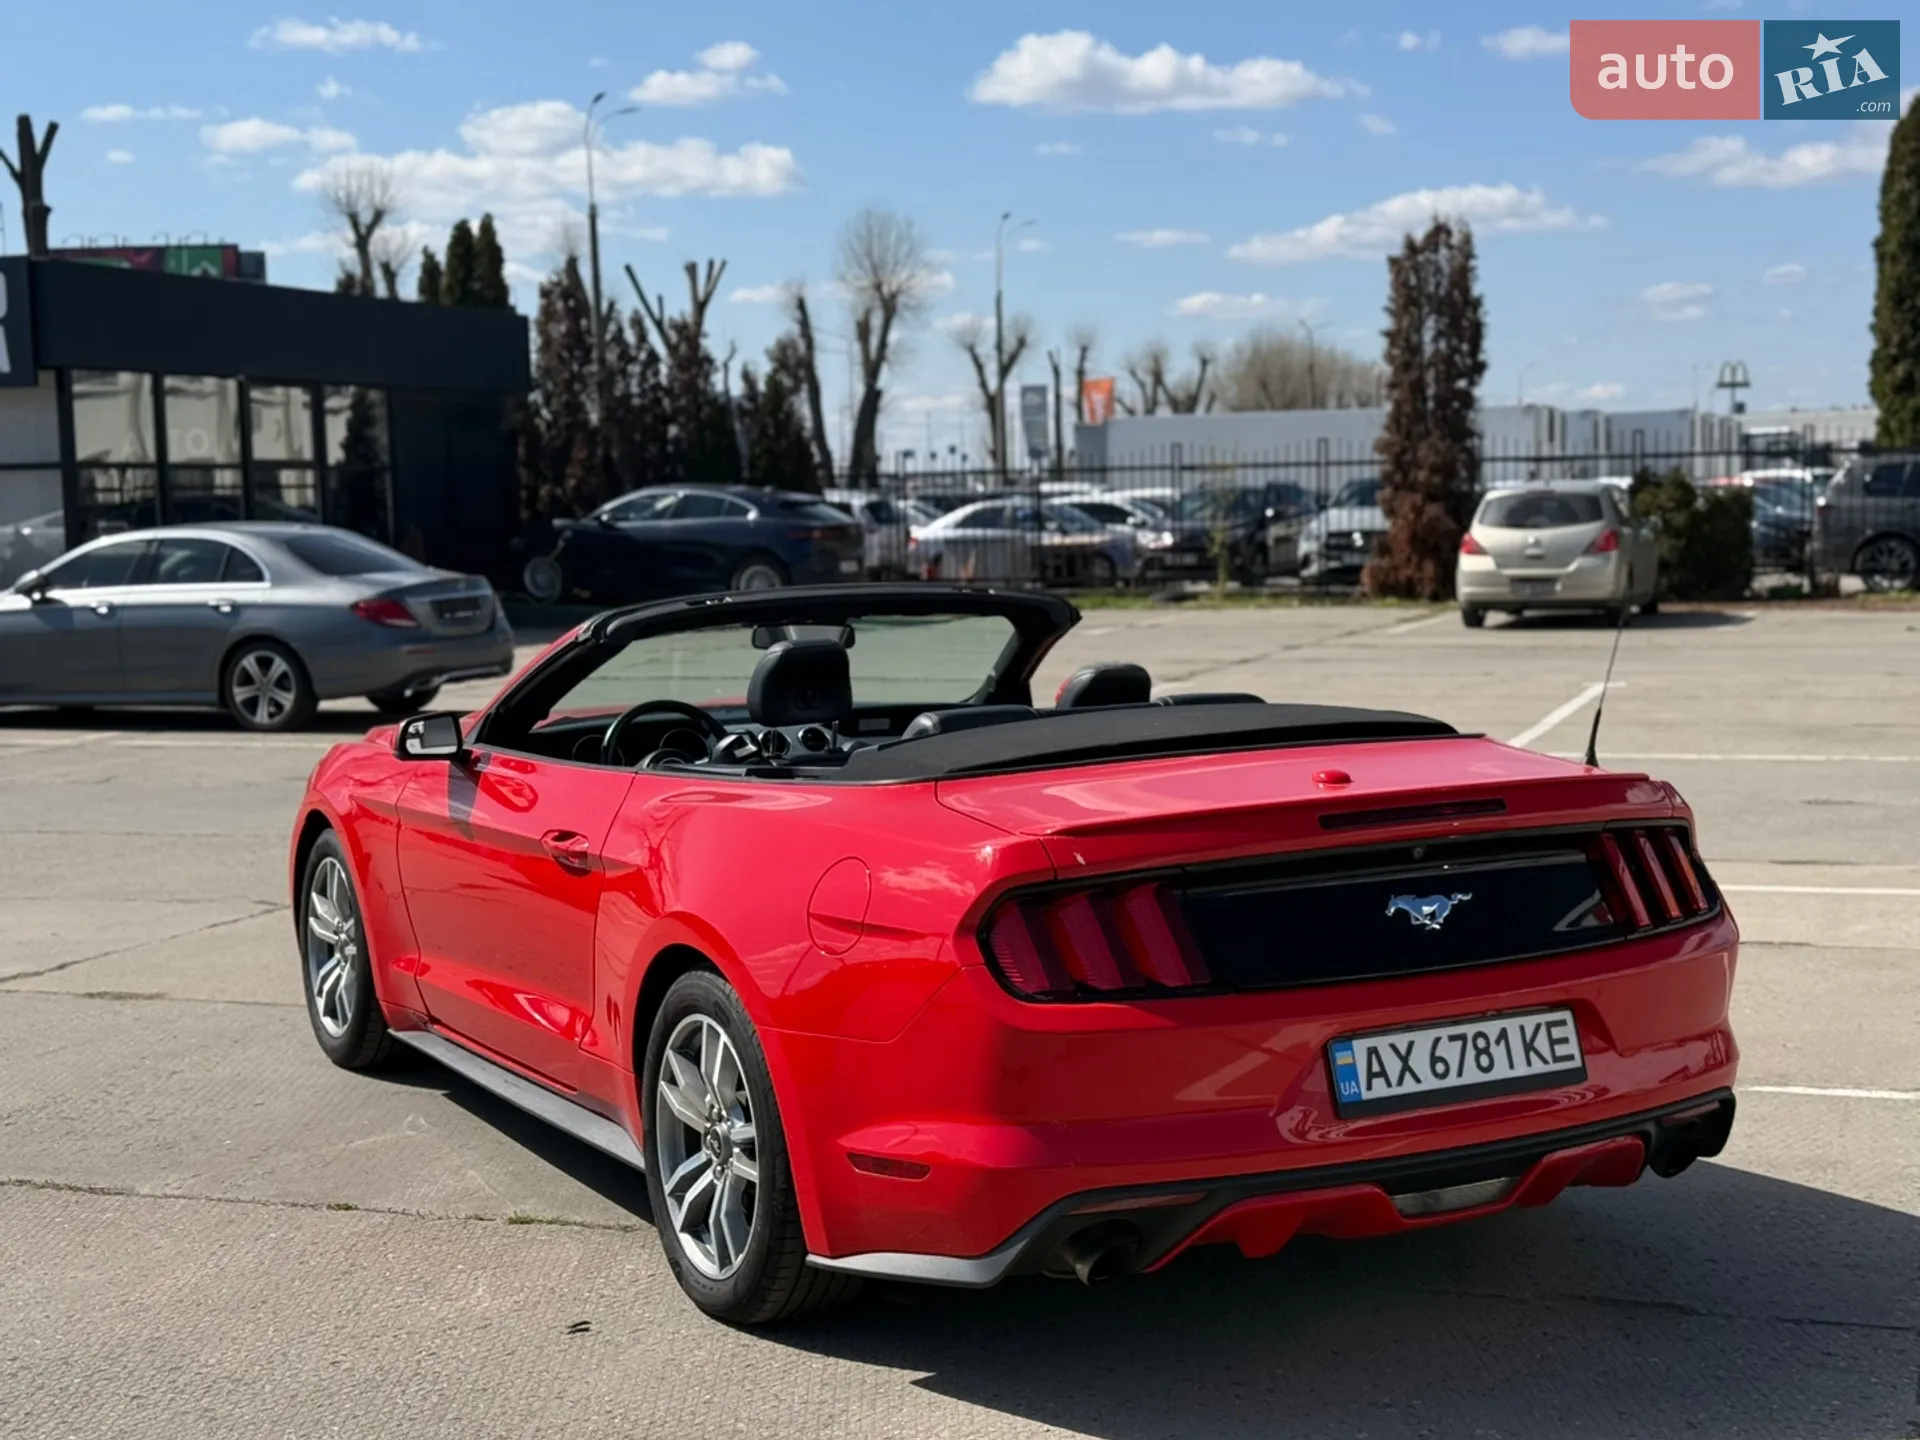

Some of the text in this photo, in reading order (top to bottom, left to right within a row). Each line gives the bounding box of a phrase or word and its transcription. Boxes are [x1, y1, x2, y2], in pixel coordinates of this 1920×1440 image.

[1365, 1039, 1423, 1091] AX
[1518, 1018, 1576, 1068] KE
[1340, 1080, 1360, 1096] UA
